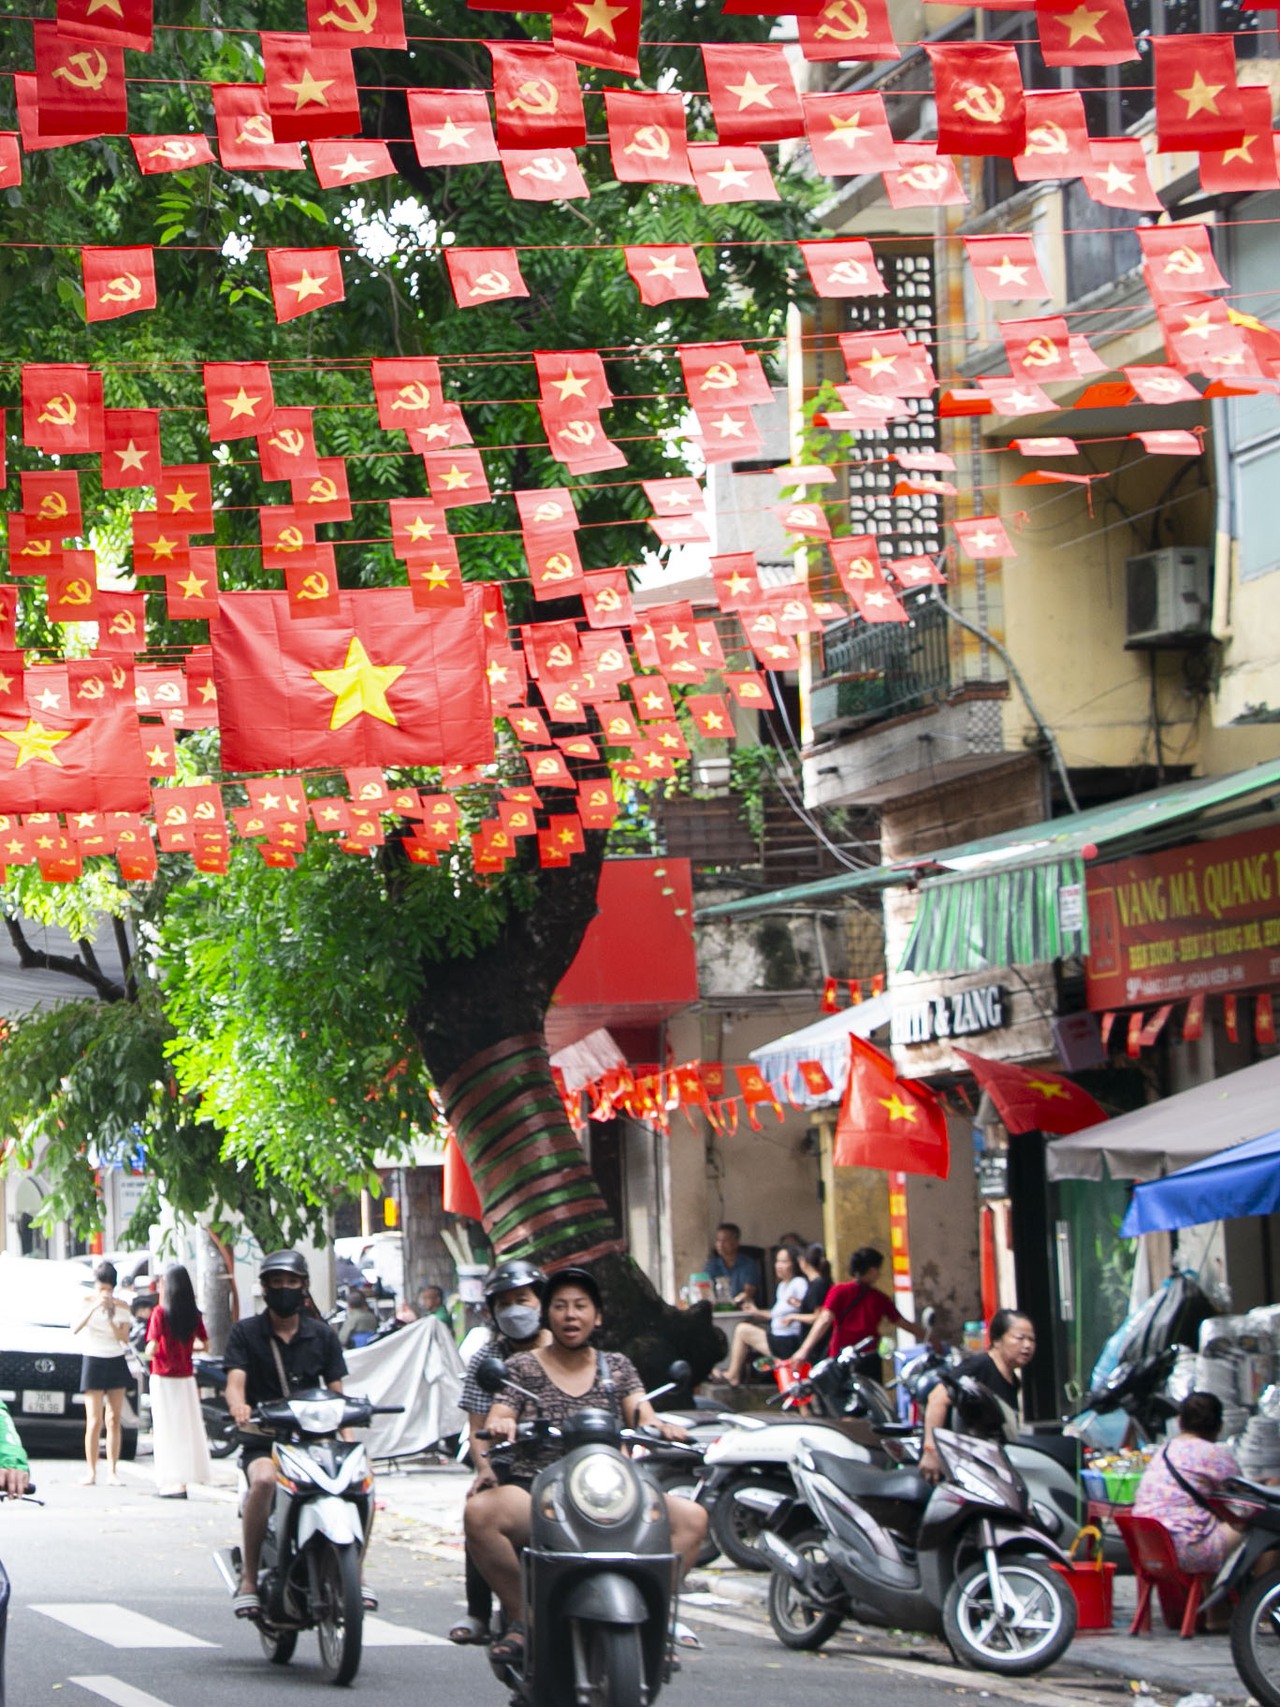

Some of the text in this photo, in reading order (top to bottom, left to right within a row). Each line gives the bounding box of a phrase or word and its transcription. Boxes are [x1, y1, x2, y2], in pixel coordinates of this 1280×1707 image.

[1117, 870, 1166, 927] VÀNG
[1204, 853, 1270, 919] QUANG
[933, 996, 950, 1037] &
[951, 986, 1003, 1034] ZANG
